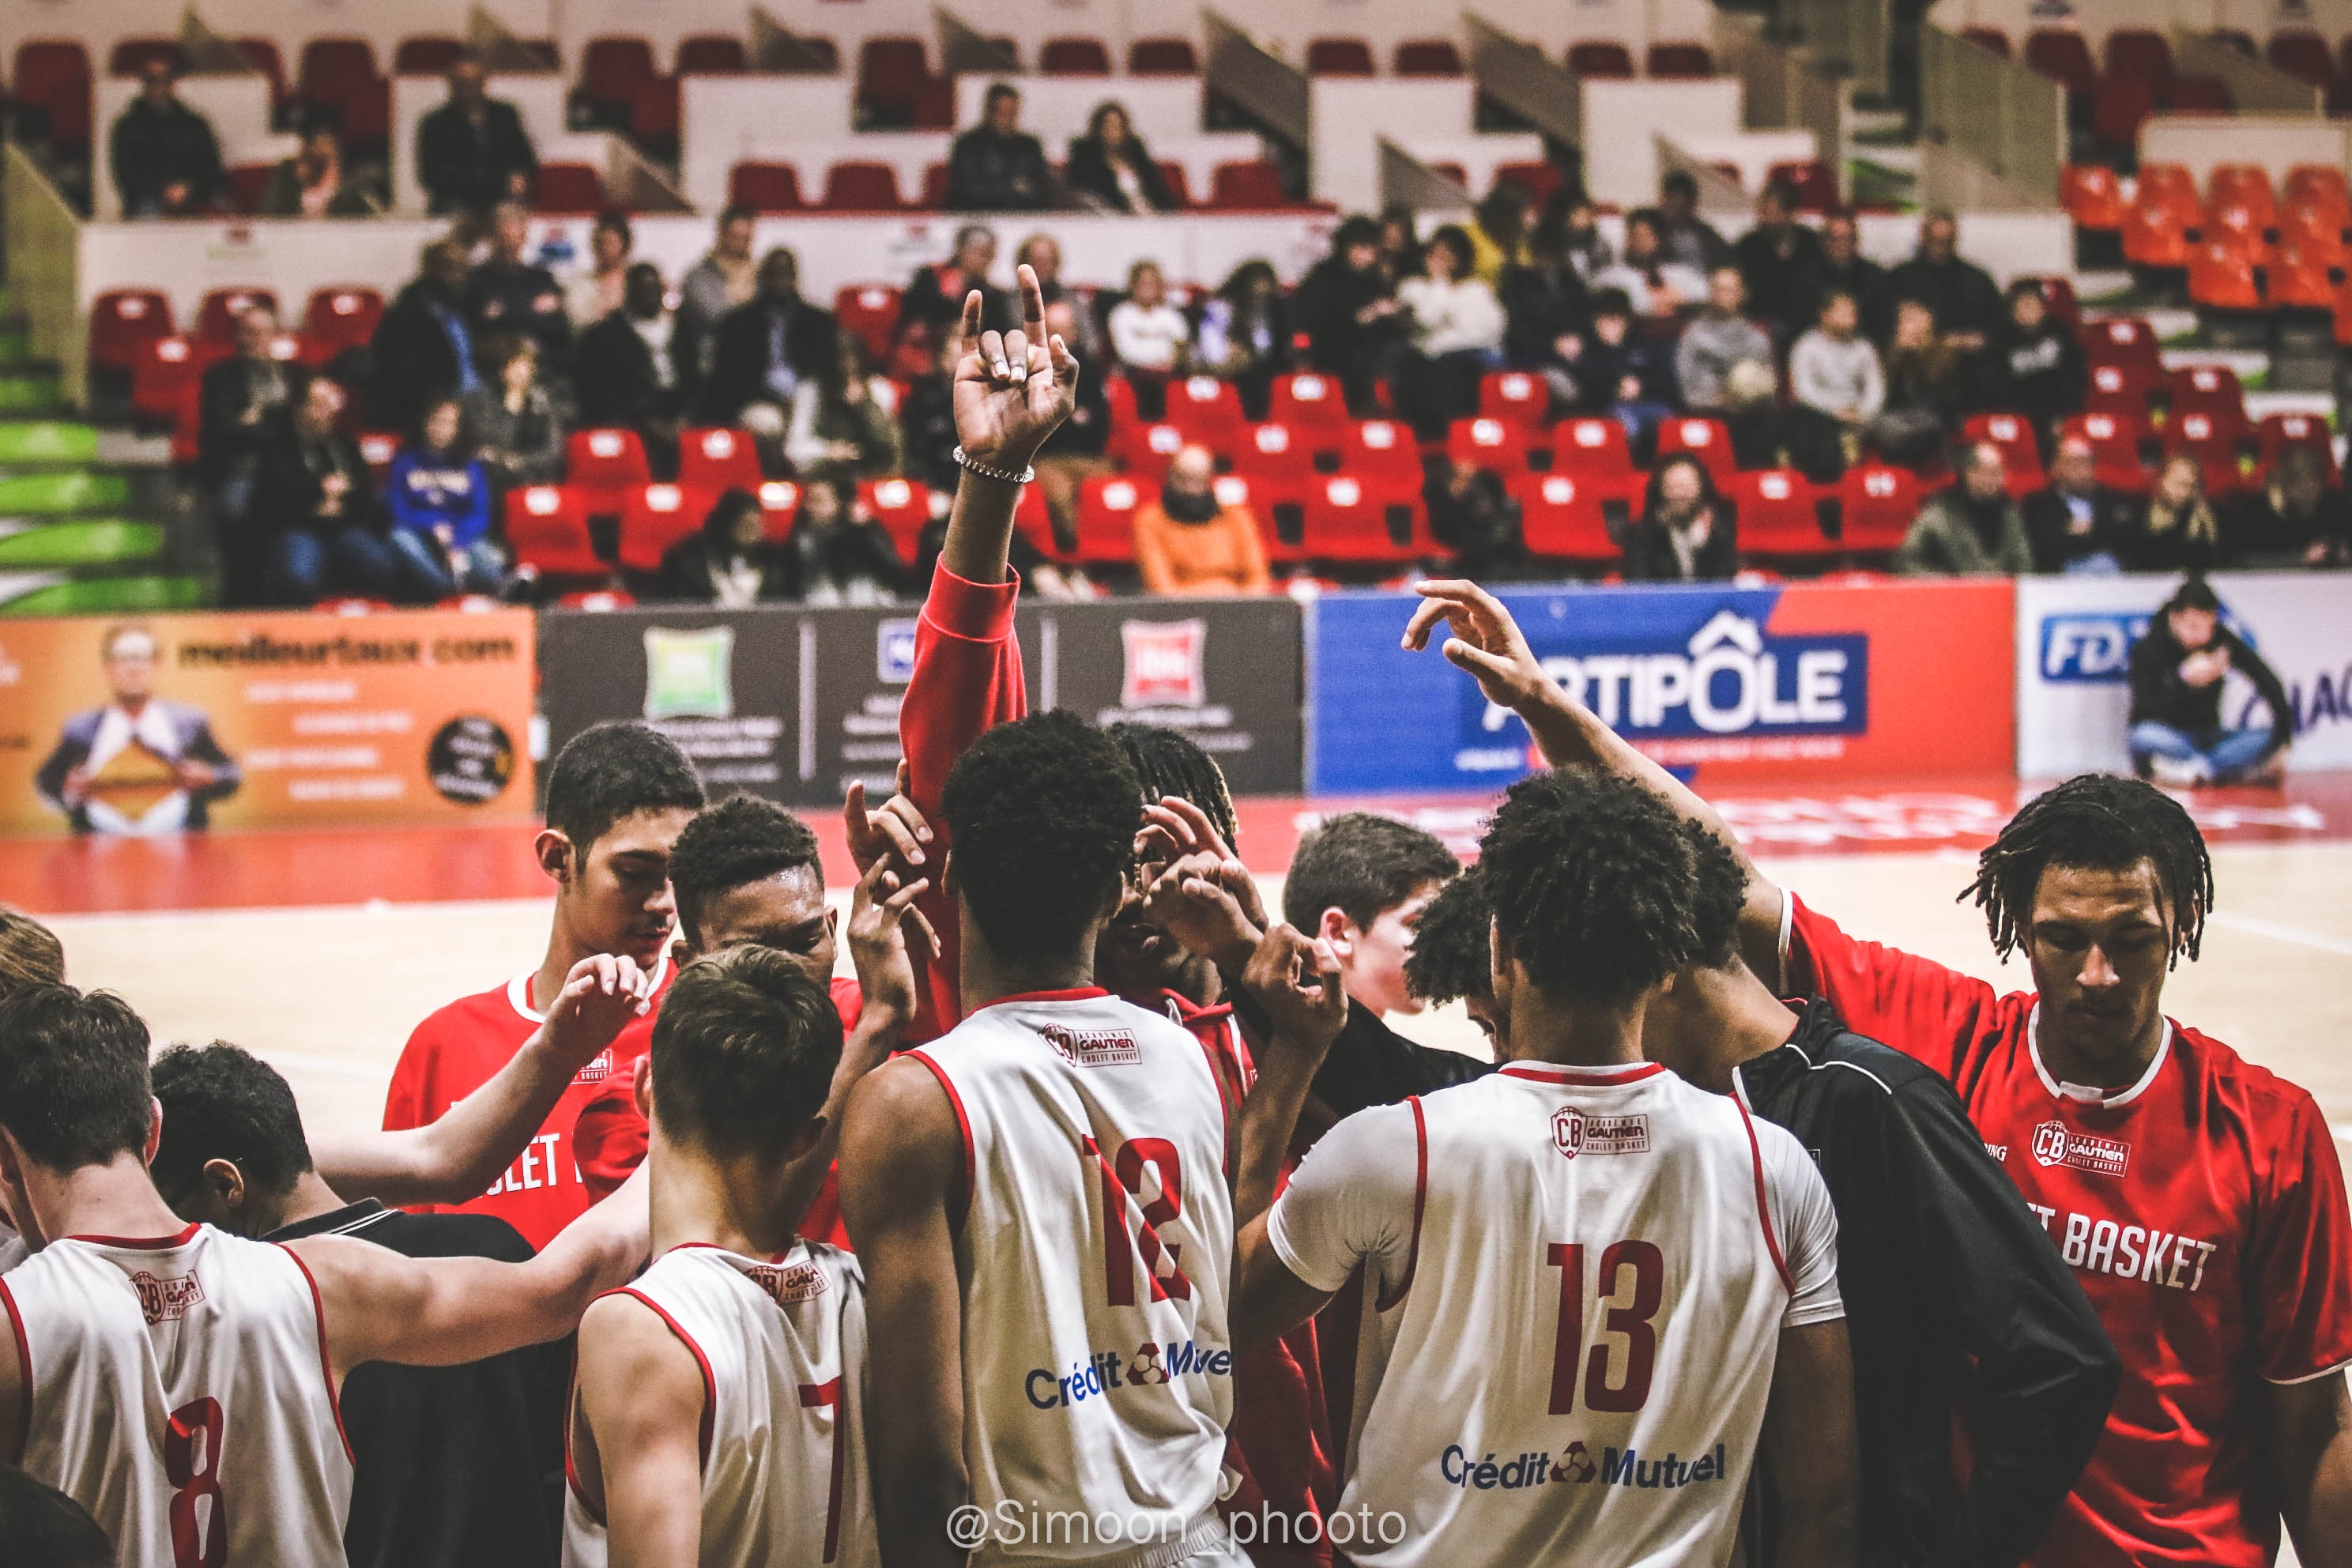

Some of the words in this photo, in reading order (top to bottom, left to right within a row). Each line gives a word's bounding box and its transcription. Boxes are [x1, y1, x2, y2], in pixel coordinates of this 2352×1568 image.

[2045, 622, 2131, 677] FD
[1080, 1038, 1135, 1051] GAUTIER
[1081, 1054, 1108, 1064] CHOLET
[1112, 1052, 1137, 1062] BASKET
[1557, 1118, 1581, 1148] CB
[1587, 1125, 1645, 1139] GAUTIER
[1615, 1140, 1645, 1150] BASKET
[2036, 1129, 2065, 1159] CB
[2069, 1143, 2124, 1163] GAUTIER
[2094, 1160, 2123, 1173] BASKET
[2062, 1212, 2218, 1291] BASKET
[1547, 1239, 1664, 1415] 13
[1025, 1352, 1123, 1411] Crédit
[1441, 1444, 1551, 1490] Crédit
[1601, 1443, 1725, 1488] Mutuel
[164, 1396, 227, 1568] 8
